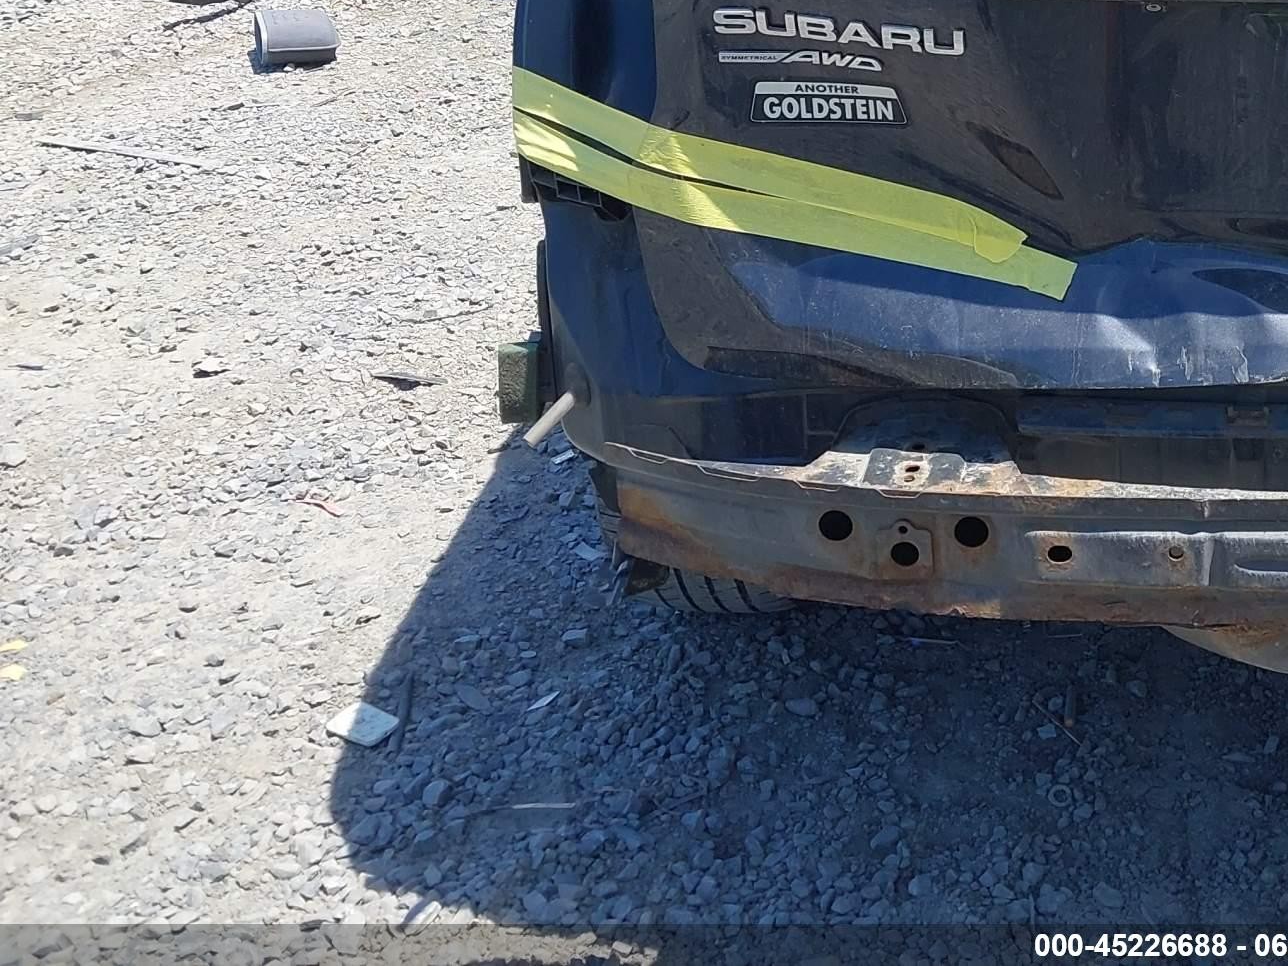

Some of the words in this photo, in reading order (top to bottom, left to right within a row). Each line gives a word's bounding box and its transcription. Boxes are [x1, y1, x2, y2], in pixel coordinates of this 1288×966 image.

[712, 8, 965, 56] SUBARU
[720, 54, 778, 62] SYMMETRICAL
[781, 50, 883, 72] AWD
[794, 83, 859, 95] ANOTHER
[763, 96, 894, 121] GOLDSTEIN
